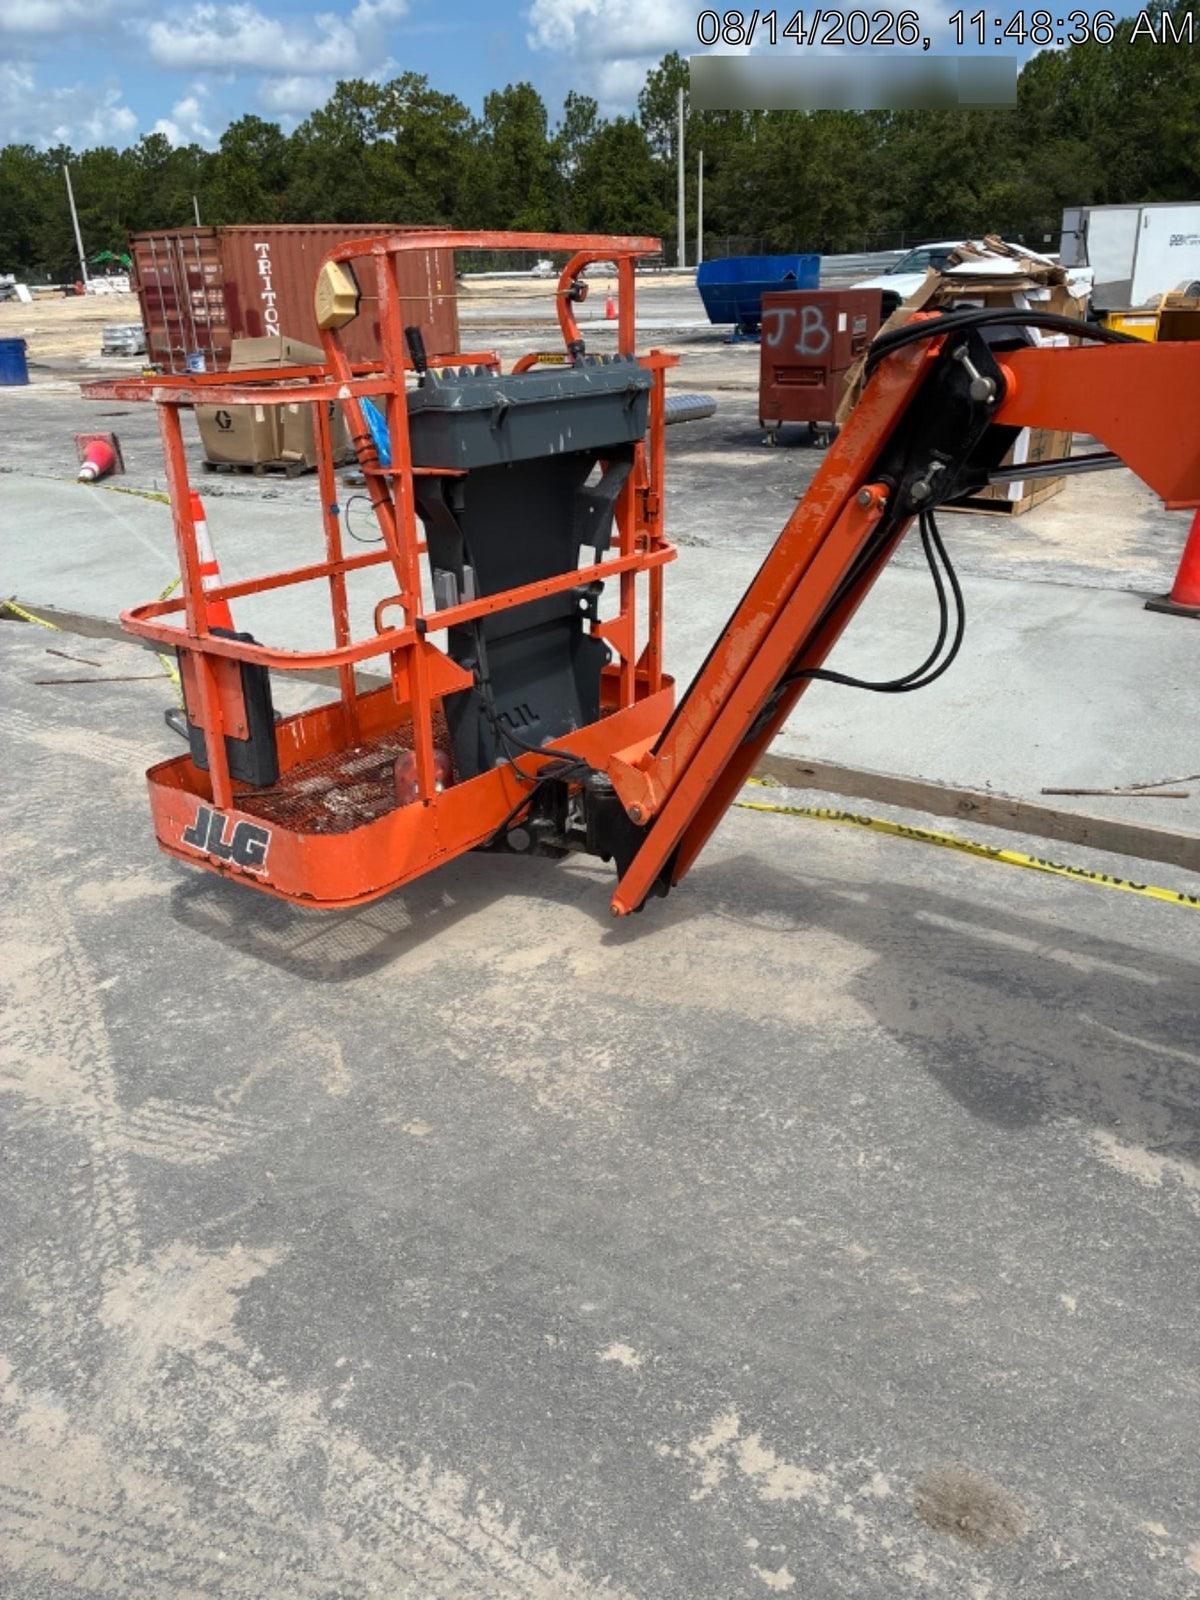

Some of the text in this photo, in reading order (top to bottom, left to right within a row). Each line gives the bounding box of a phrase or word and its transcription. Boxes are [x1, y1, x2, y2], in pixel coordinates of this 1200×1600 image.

[254, 243, 280, 337] TRITON
[762, 305, 831, 355] JB
[181, 804, 272, 877] JLG
